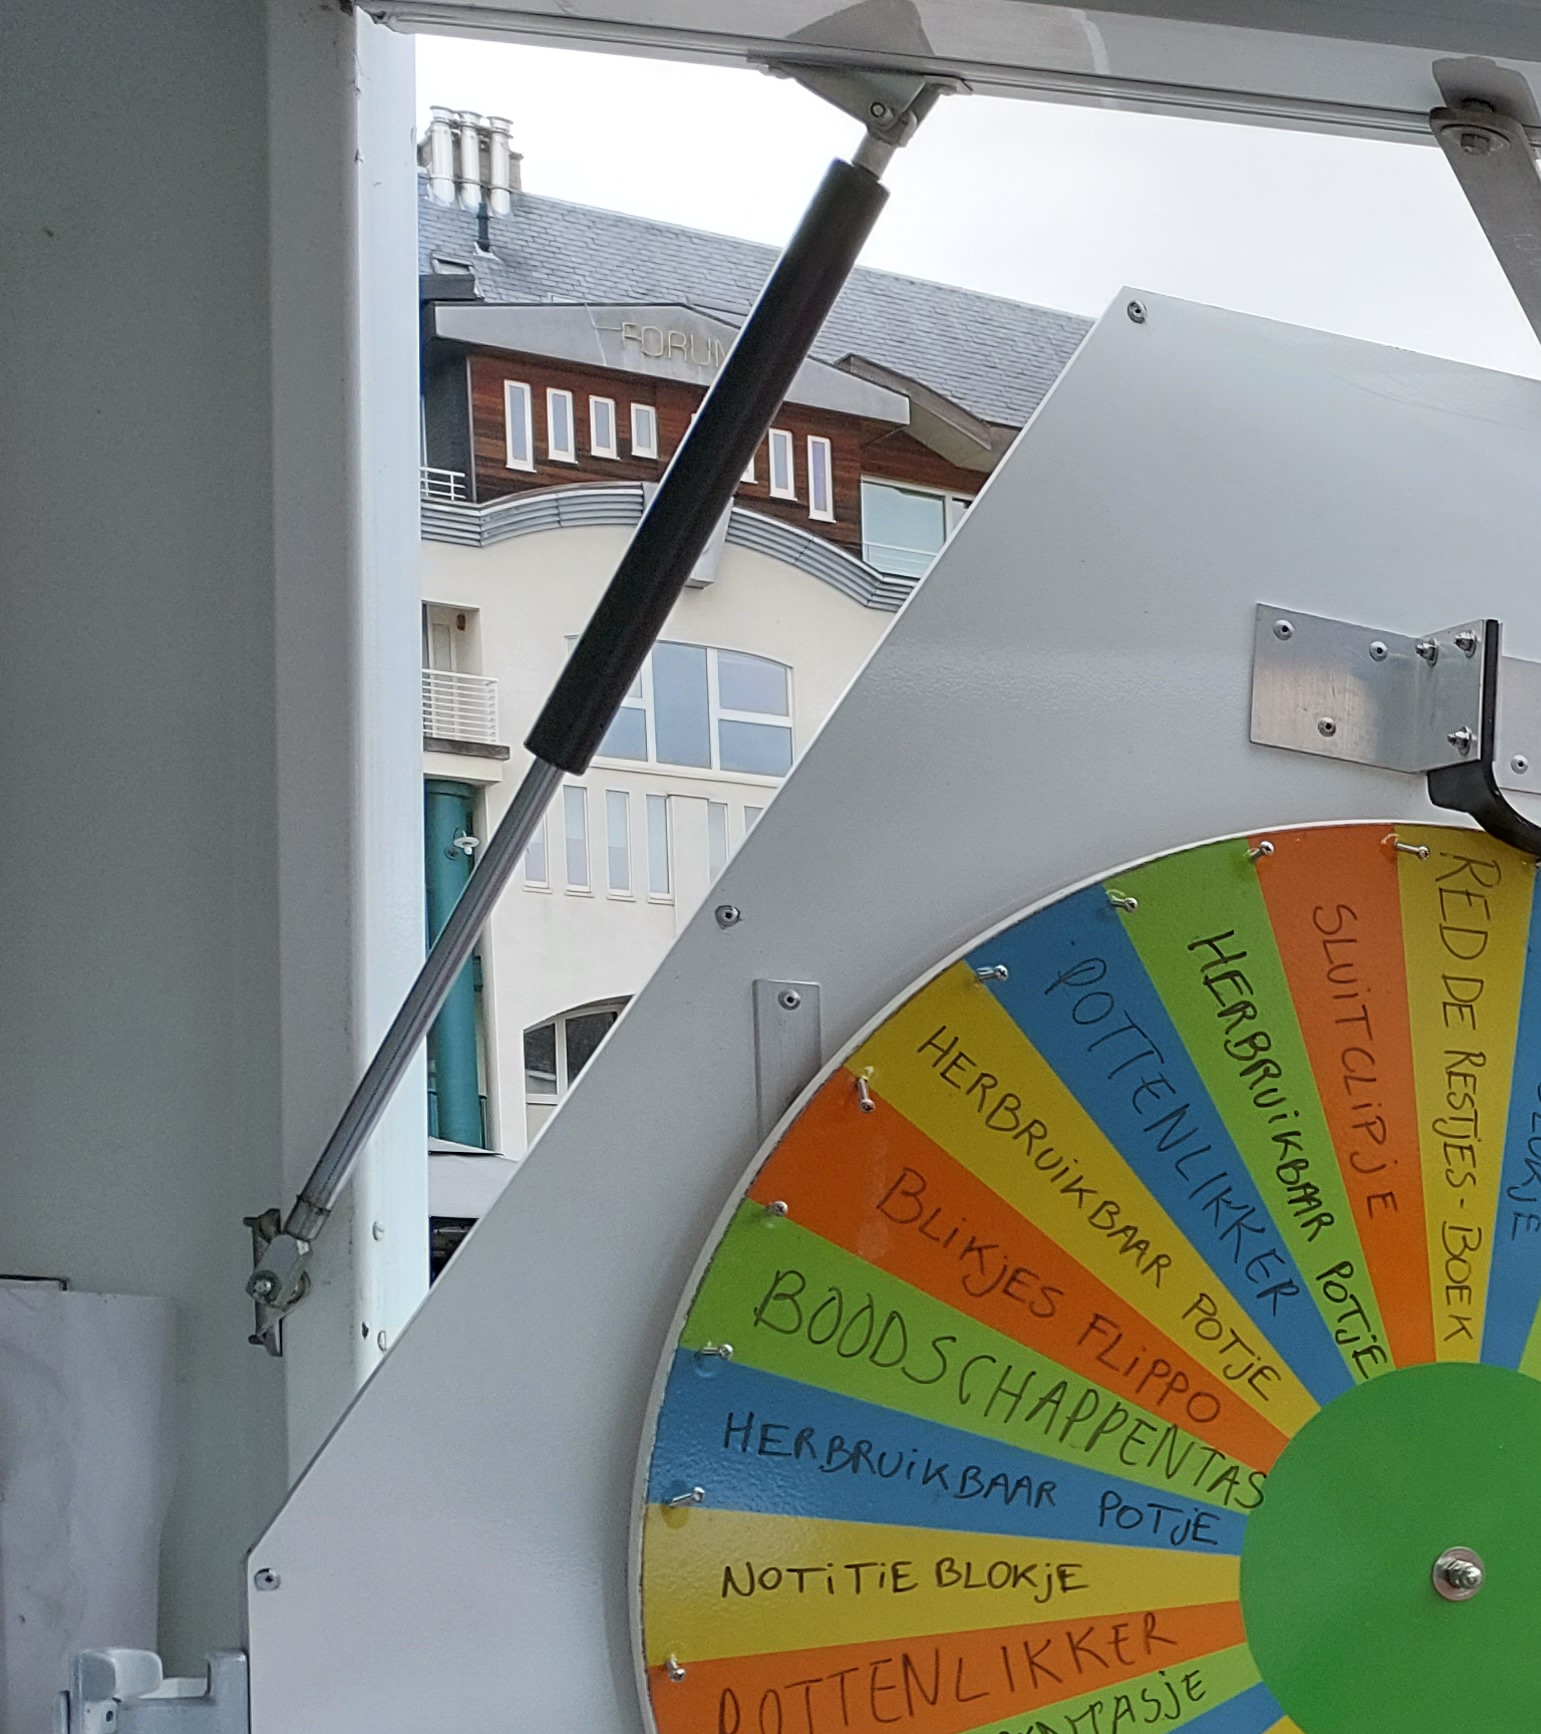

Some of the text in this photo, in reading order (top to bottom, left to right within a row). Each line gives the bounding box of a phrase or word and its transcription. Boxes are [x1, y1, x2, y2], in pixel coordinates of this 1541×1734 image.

[1433, 851, 1509, 962] RED
[1440, 972, 1486, 1032] DE
[1043, 956, 1301, 1318] POTTENLIKKER
[1440, 1219, 1484, 1343] BOEK
[752, 1268, 1270, 1510] BOODSCHAPPENTAS
